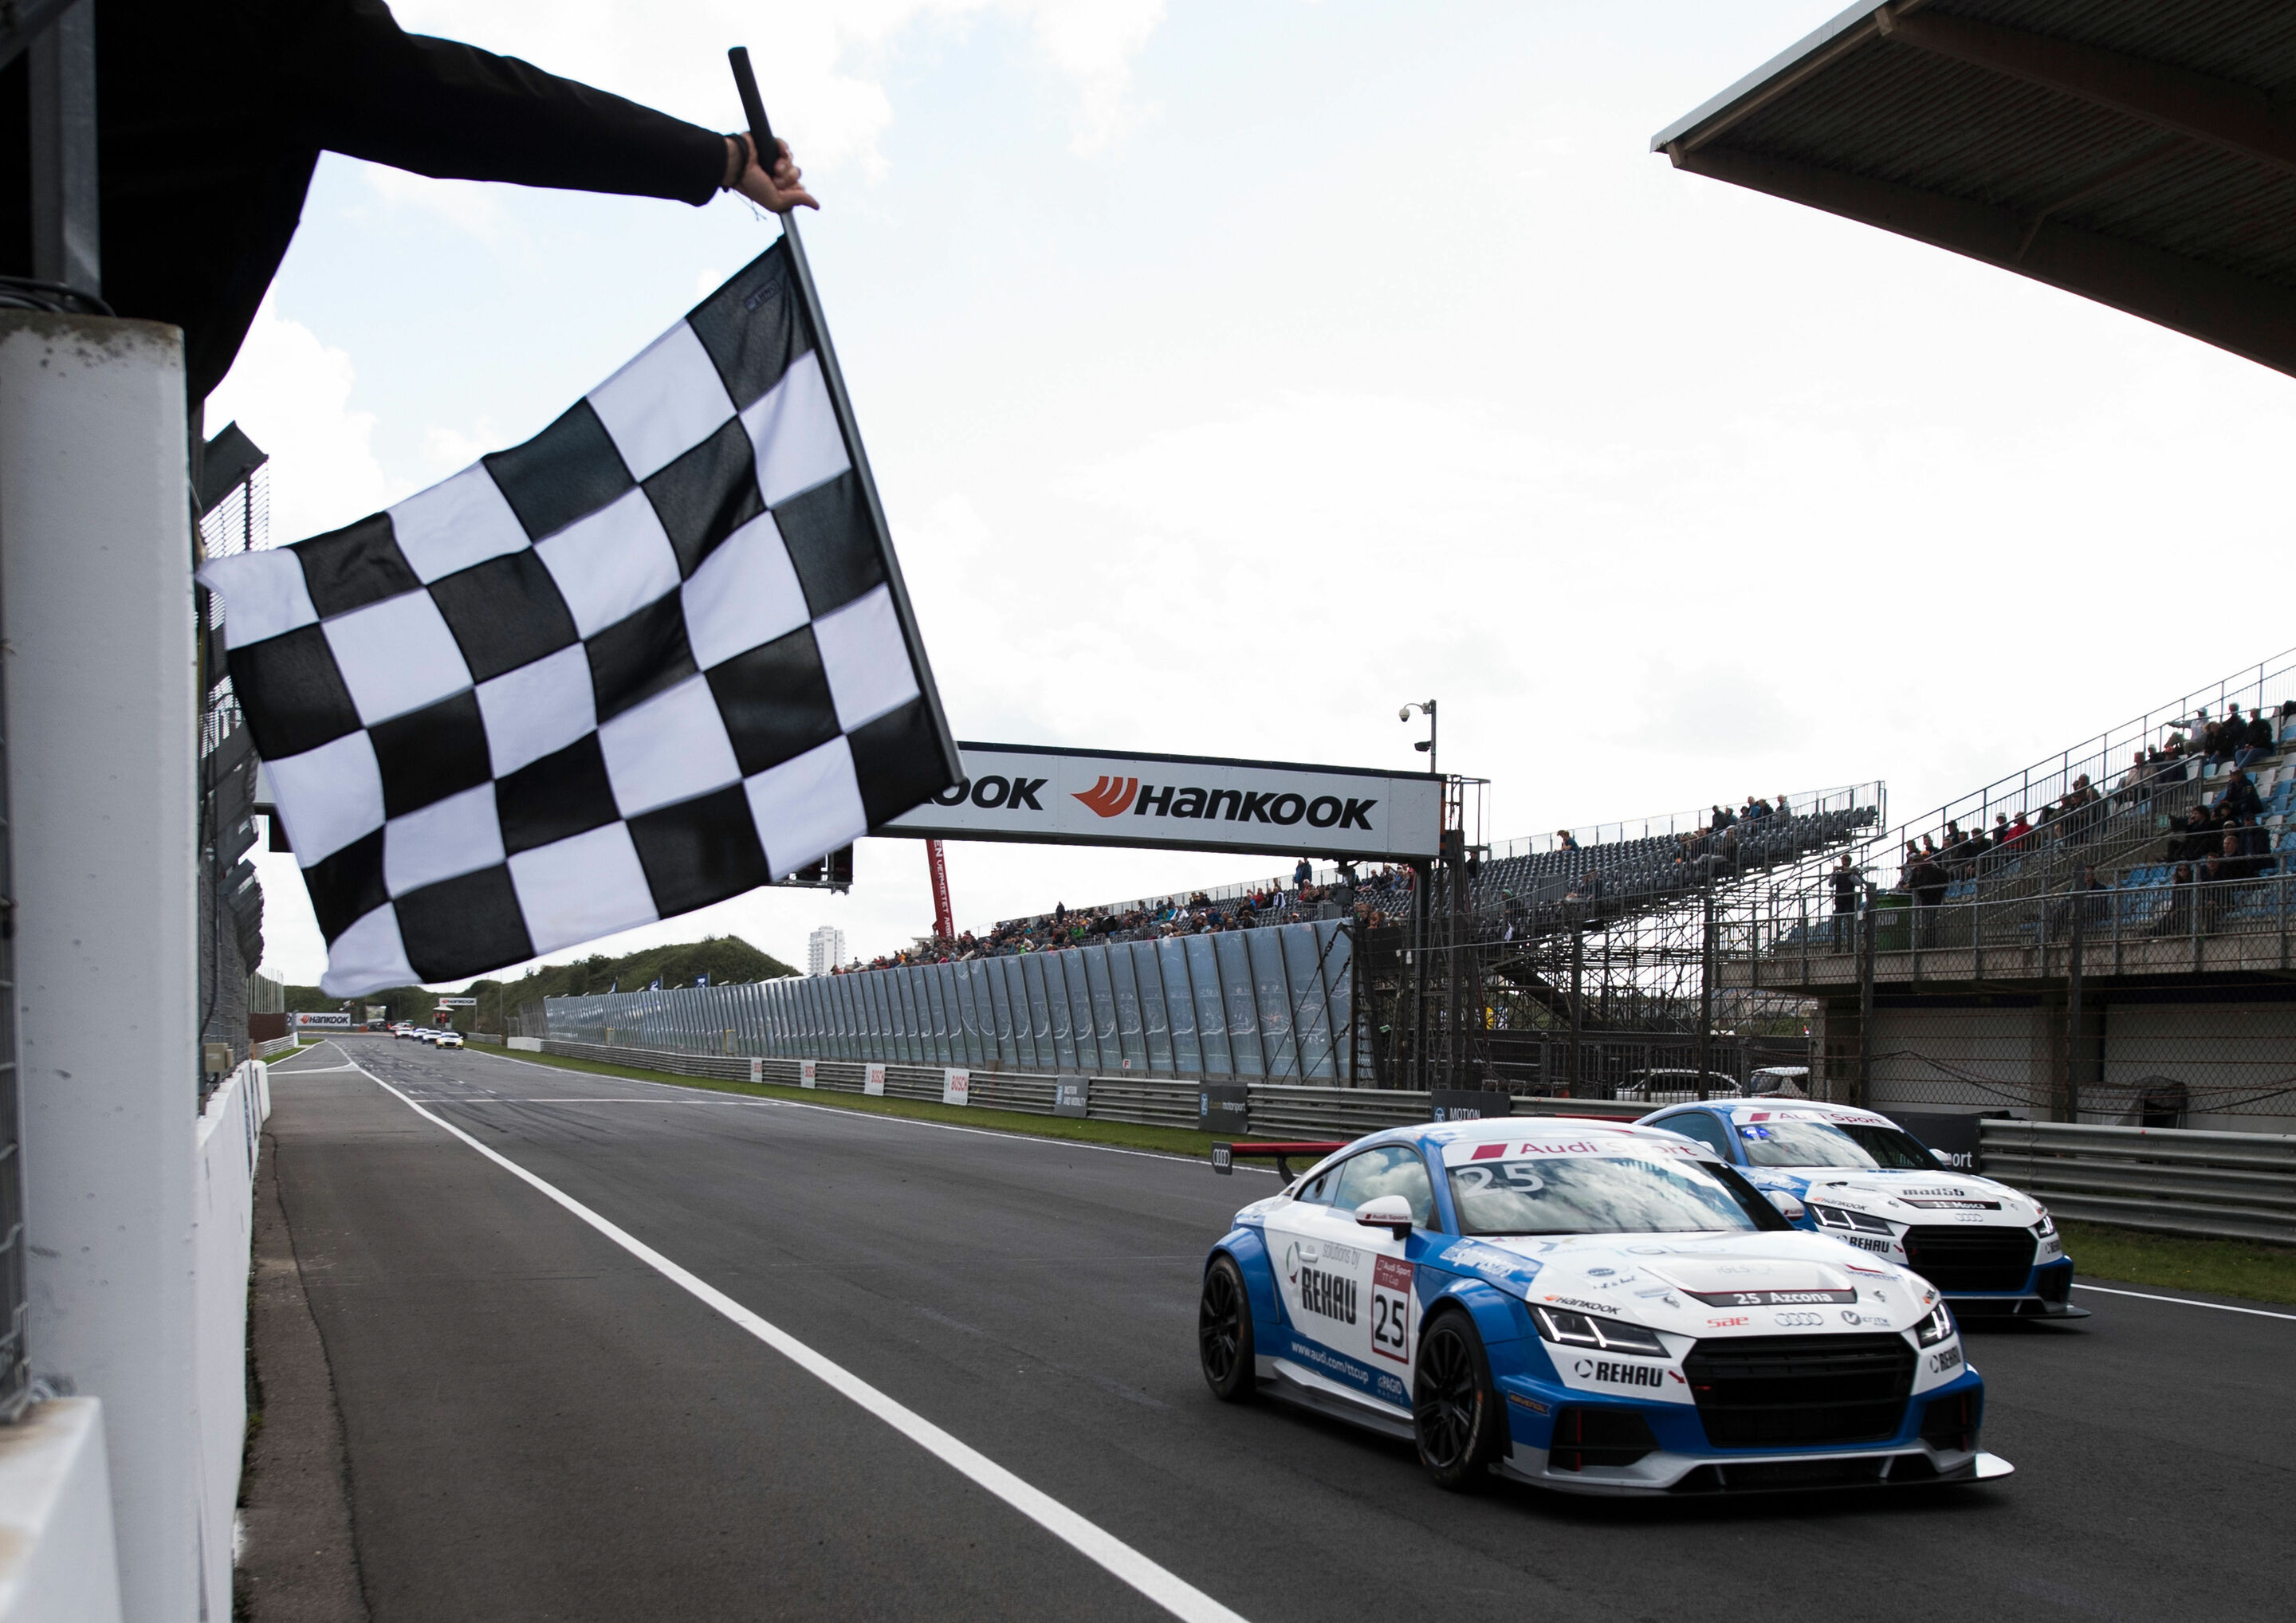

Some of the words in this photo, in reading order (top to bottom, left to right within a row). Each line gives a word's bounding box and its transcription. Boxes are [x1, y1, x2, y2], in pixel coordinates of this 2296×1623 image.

[922, 775, 1049, 812] OOK
[951, 1075, 967, 1091] BOSCH
[1450, 1107, 1480, 1121] MOTION
[1830, 1114, 1887, 1126] Sport
[1520, 1141, 1598, 1155] Audi
[1605, 1140, 1698, 1158] Sport
[1456, 1162, 1544, 1199] 25
[1323, 1243, 1350, 1264] solutions
[1849, 1236, 1889, 1253] REHAU
[1384, 1262, 1396, 1272] Audi
[1395, 1264, 1412, 1277] Sport
[1302, 1266, 1357, 1326] REHAU
[1734, 1293, 1761, 1305] 25
[1771, 1292, 1834, 1304] Azcona
[1374, 1294, 1405, 1349] 25
[1707, 1317, 1750, 1328] sae
[1292, 1341, 1369, 1384] www.audi.com/ttcup
[1596, 1362, 1664, 1387] REHAU
